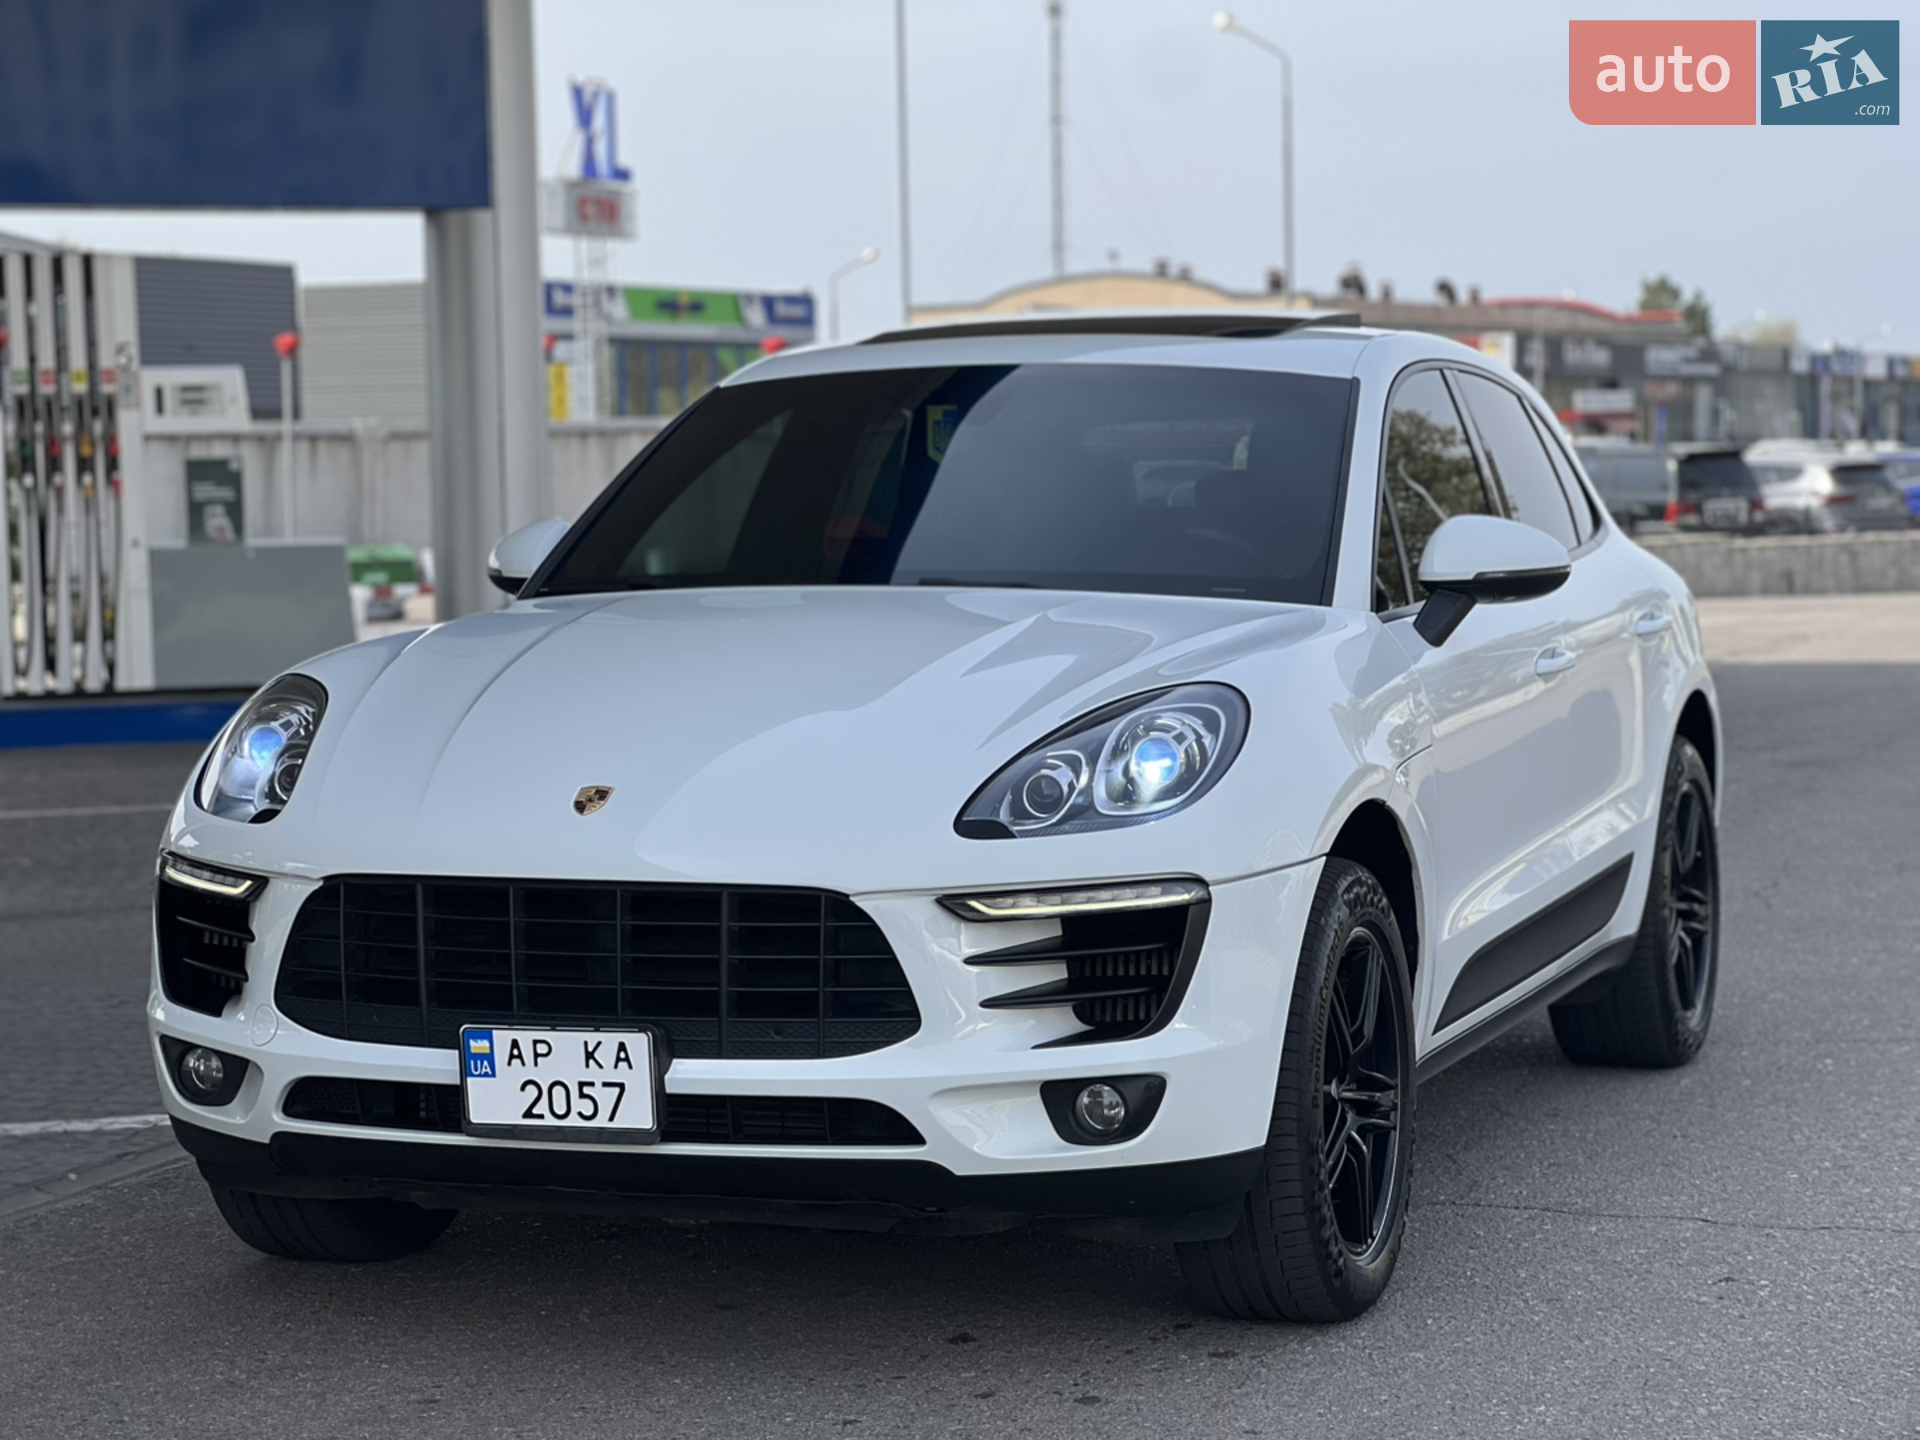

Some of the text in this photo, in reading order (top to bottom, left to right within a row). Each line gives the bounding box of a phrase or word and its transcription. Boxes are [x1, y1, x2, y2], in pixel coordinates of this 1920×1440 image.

[470, 1059, 492, 1075] UA
[507, 1038, 633, 1070] AP KA
[519, 1079, 626, 1122] 2057
